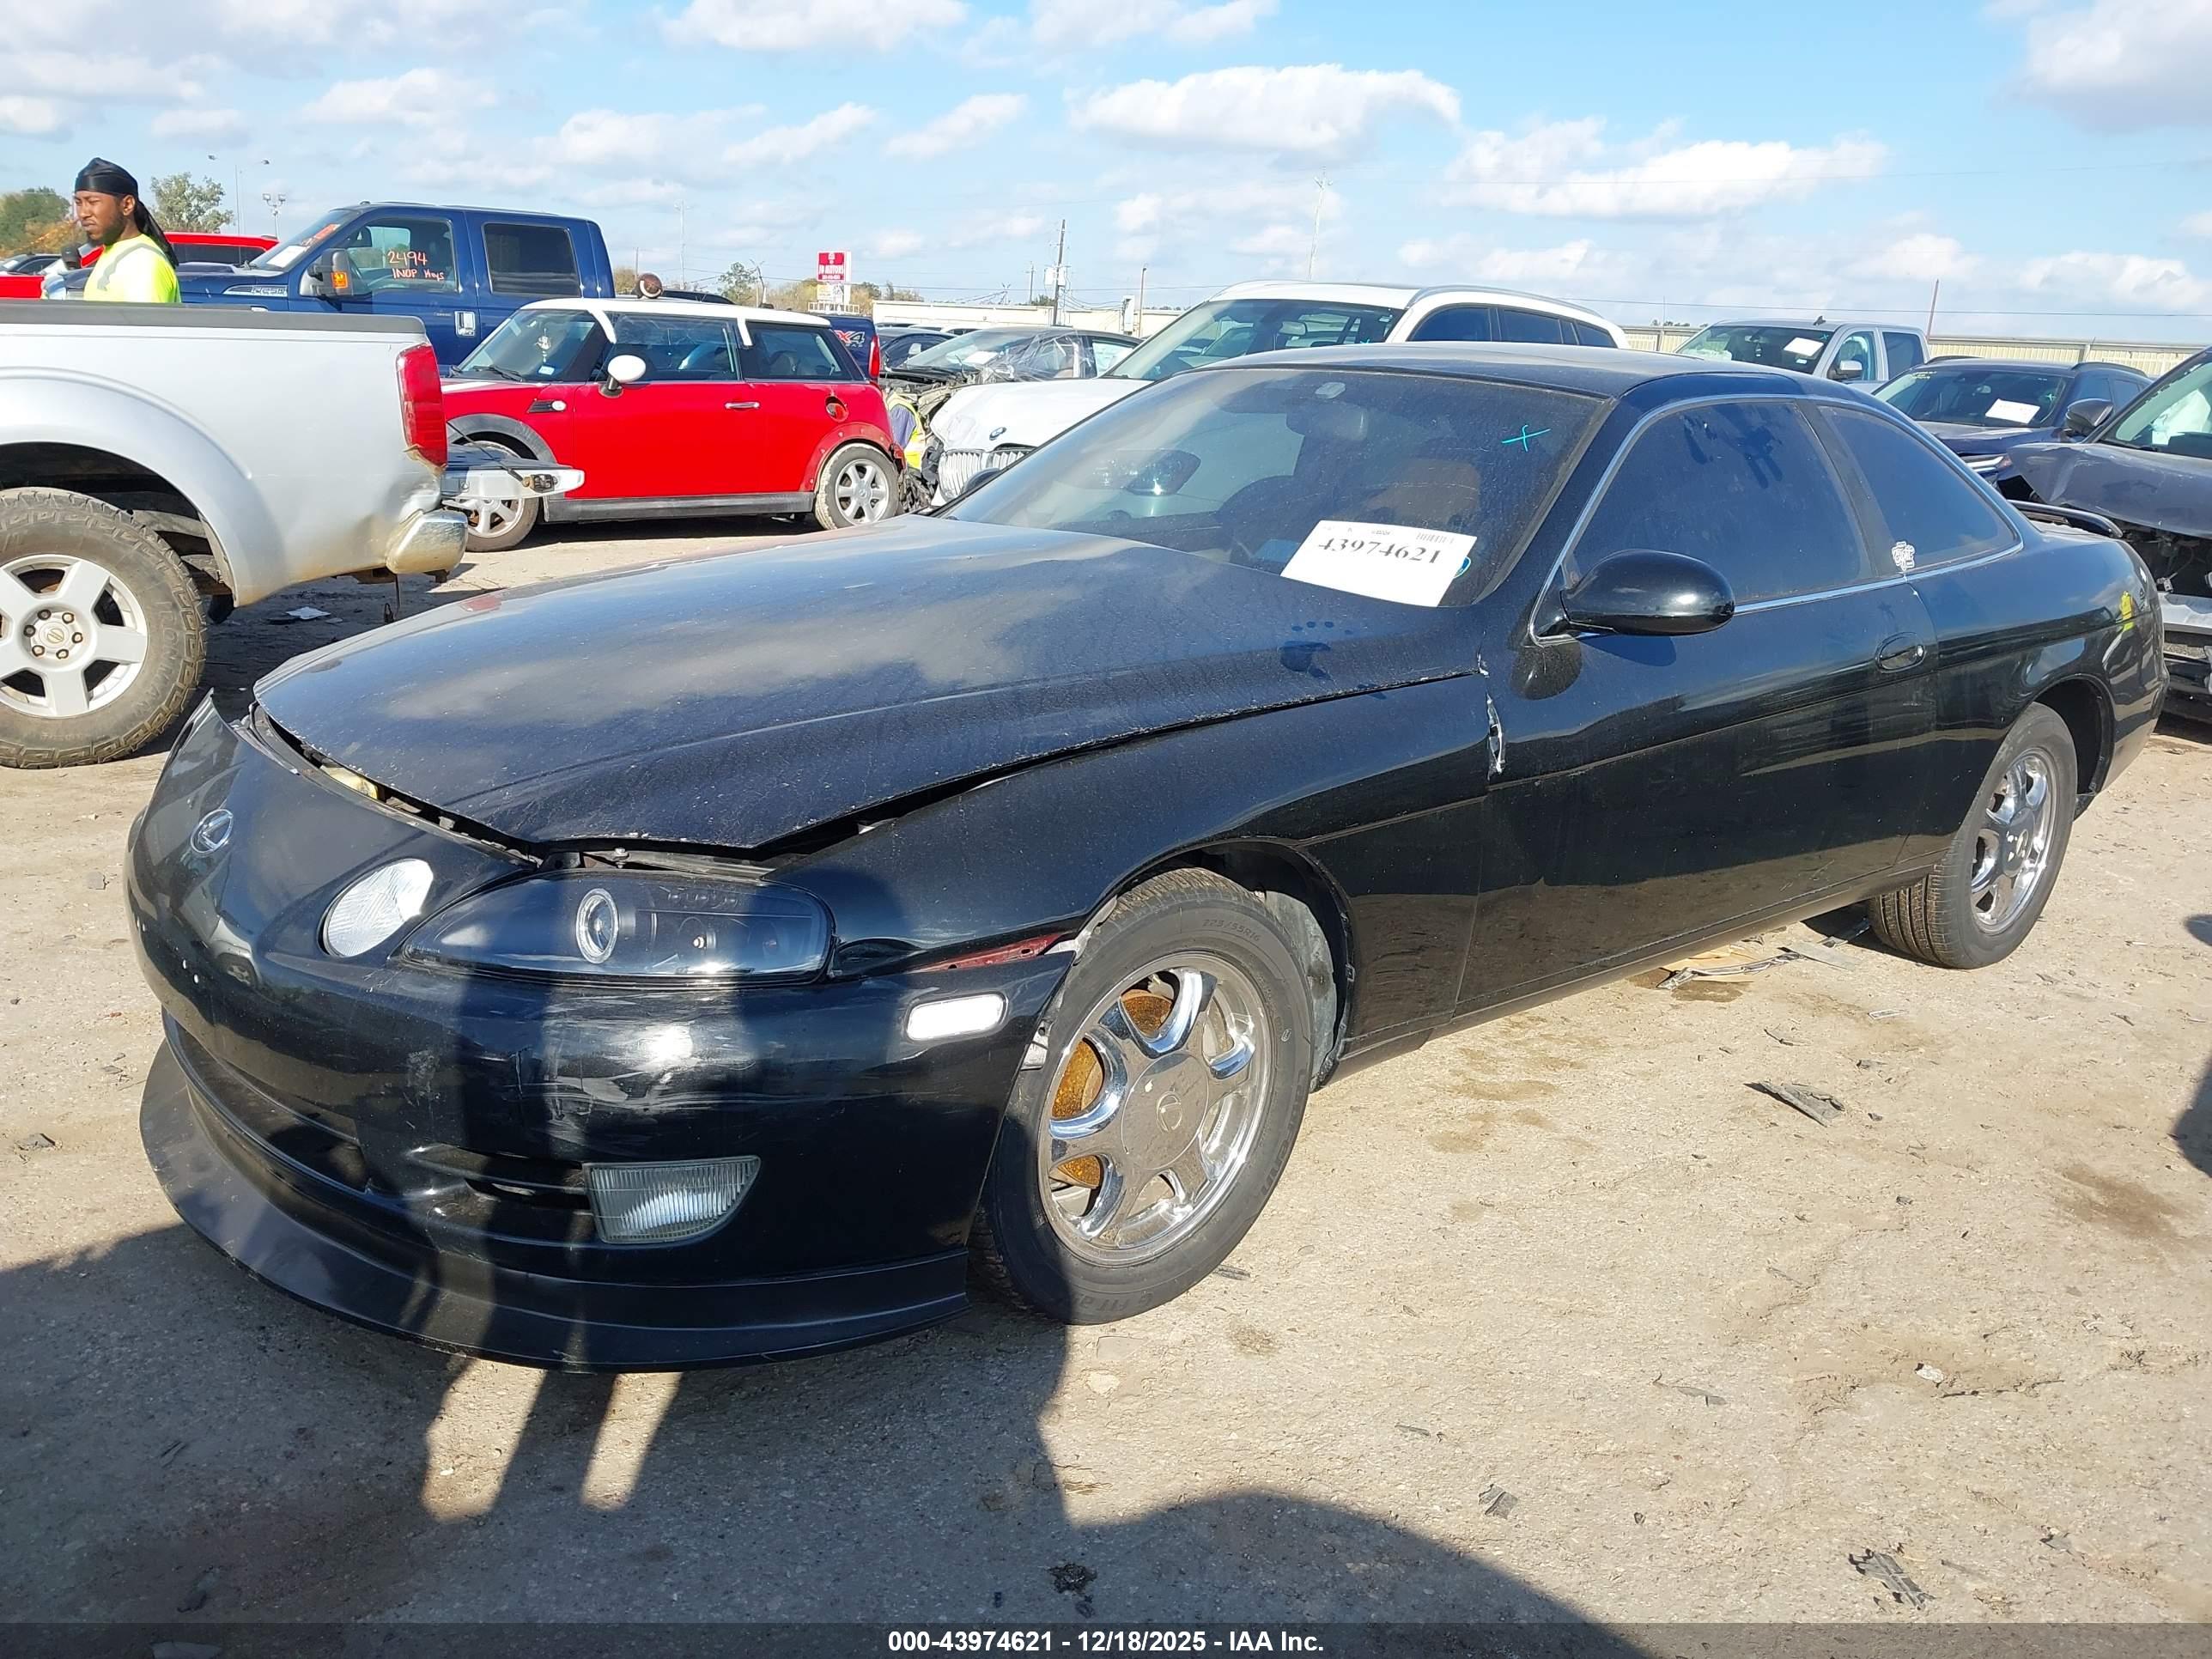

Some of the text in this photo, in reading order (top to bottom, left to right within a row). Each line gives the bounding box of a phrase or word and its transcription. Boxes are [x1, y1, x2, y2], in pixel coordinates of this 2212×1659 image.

[387, 251, 428, 266] 2494
[392, 268, 417, 278] INOP
[1318, 538, 1442, 563] 43974621
